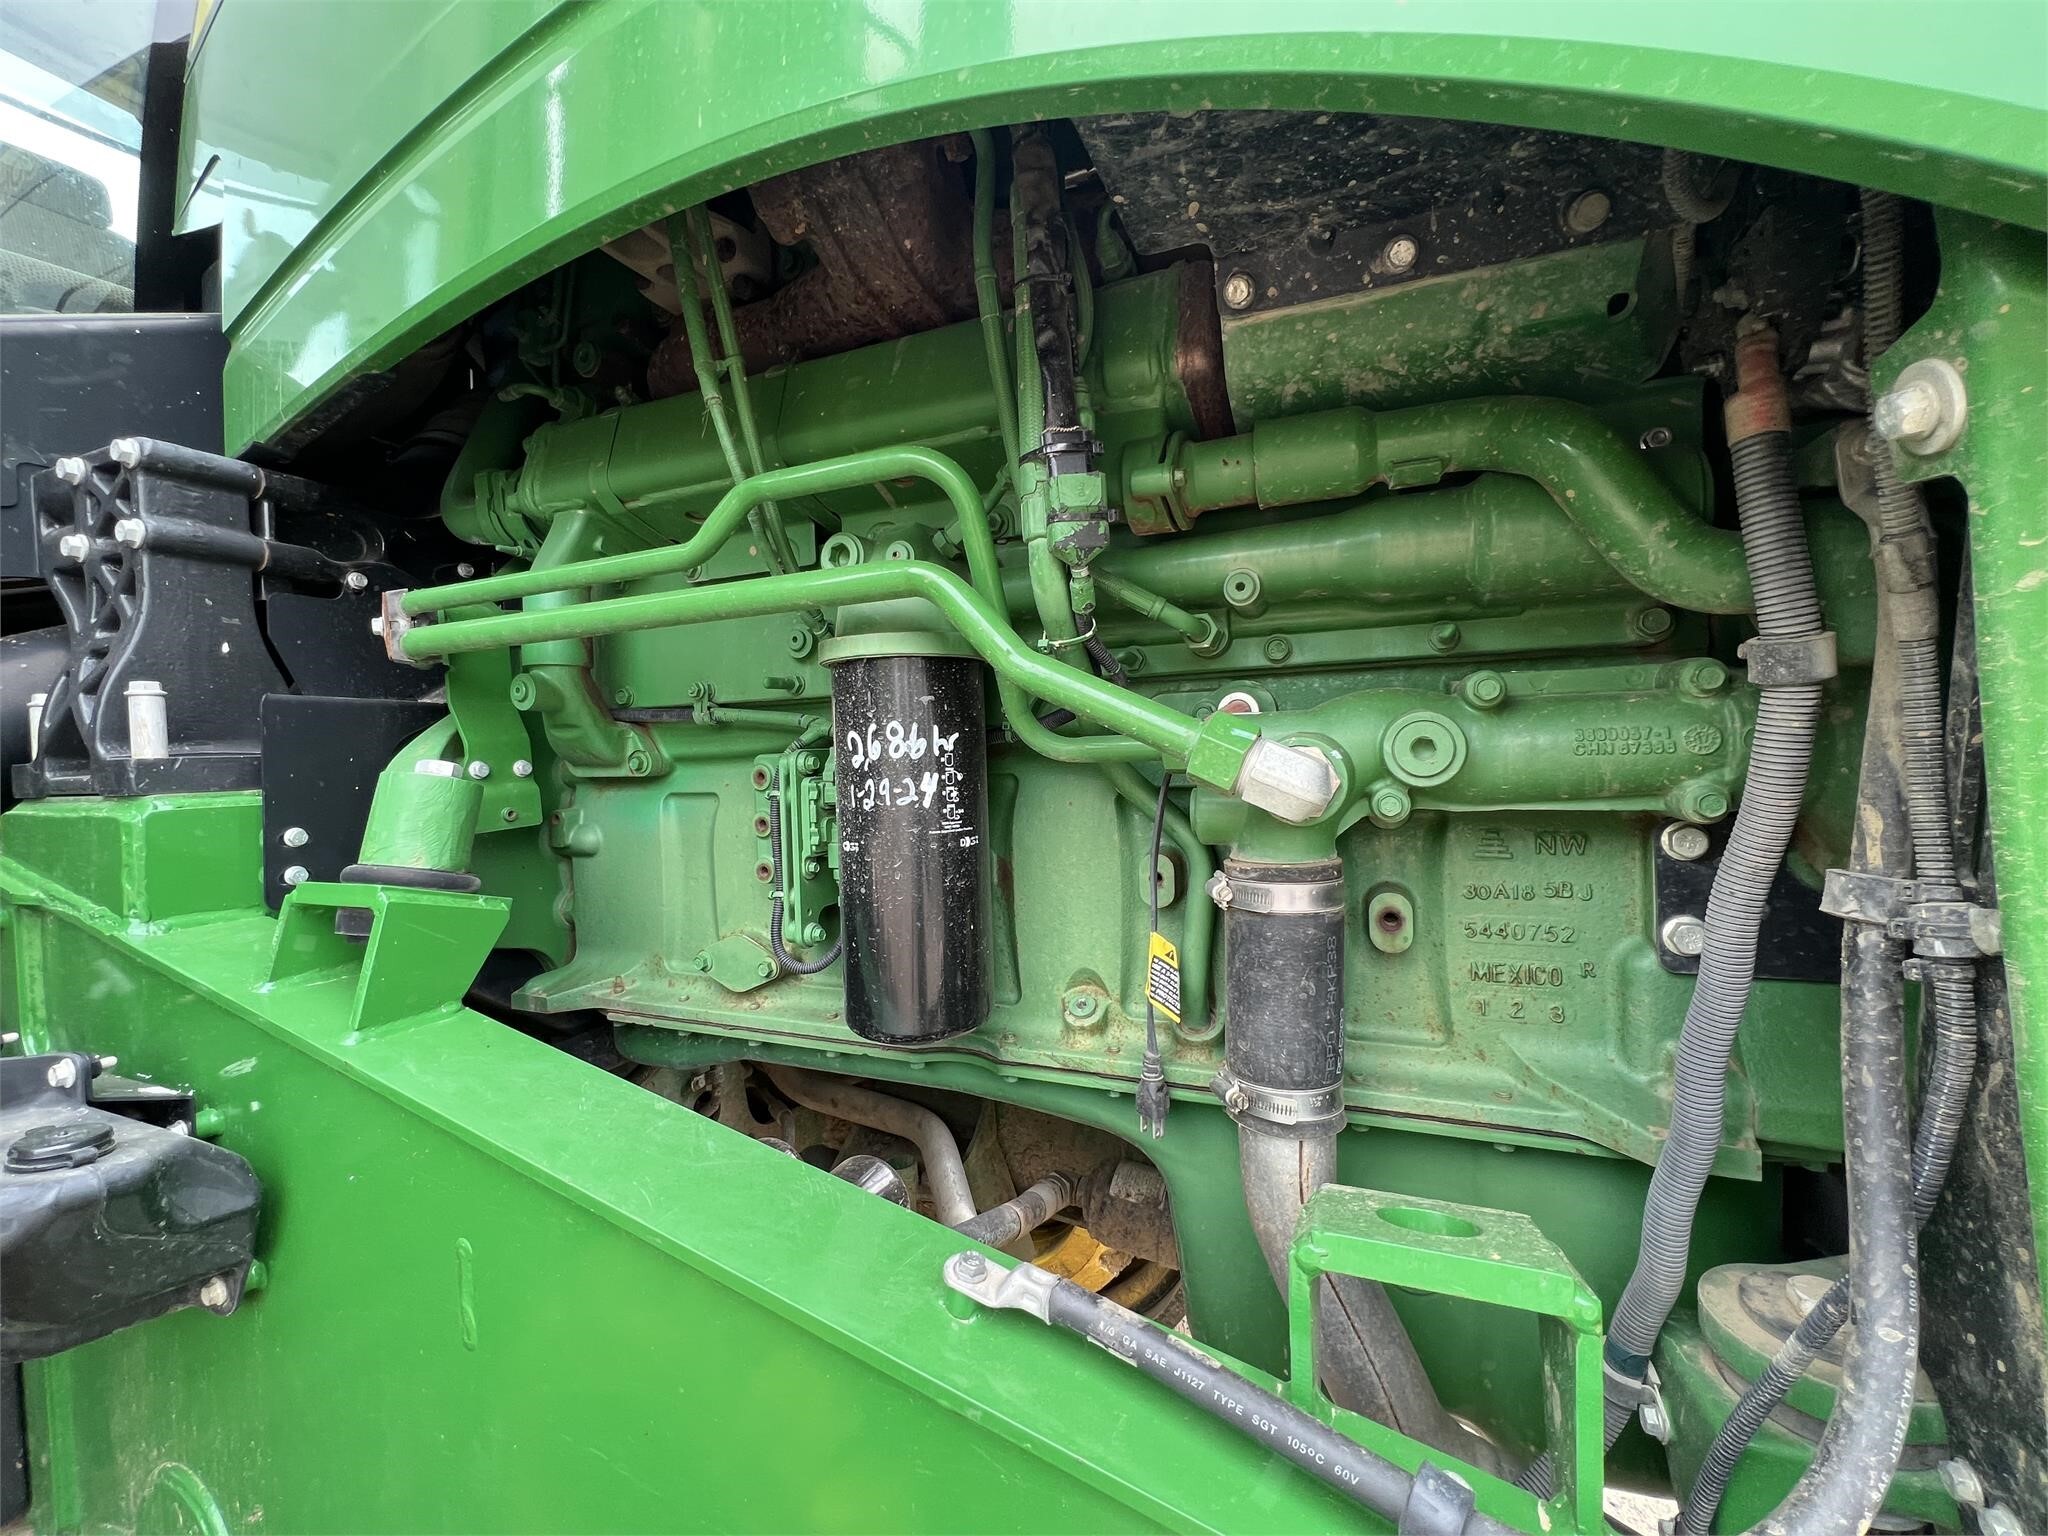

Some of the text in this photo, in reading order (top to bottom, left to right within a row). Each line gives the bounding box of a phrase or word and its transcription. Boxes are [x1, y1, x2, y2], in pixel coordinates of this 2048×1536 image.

[933, 724, 960, 756] hr
[1573, 741, 1614, 757] CHN
[850, 772, 939, 812] 1-29-24
[1535, 830, 1588, 856] NW
[1463, 921, 1576, 944] 5440752
[1470, 960, 1597, 987] MEXICO R
[1475, 999, 1565, 1023] 1 2 3
[1122, 1335, 1138, 1351] GA
[1144, 1348, 1169, 1368] SAE
[1173, 1366, 1206, 1391] J1127
[1212, 1389, 1245, 1416] TYPE
[1251, 1414, 1279, 1435] SGT
[1333, 1464, 1360, 1486] 60V
